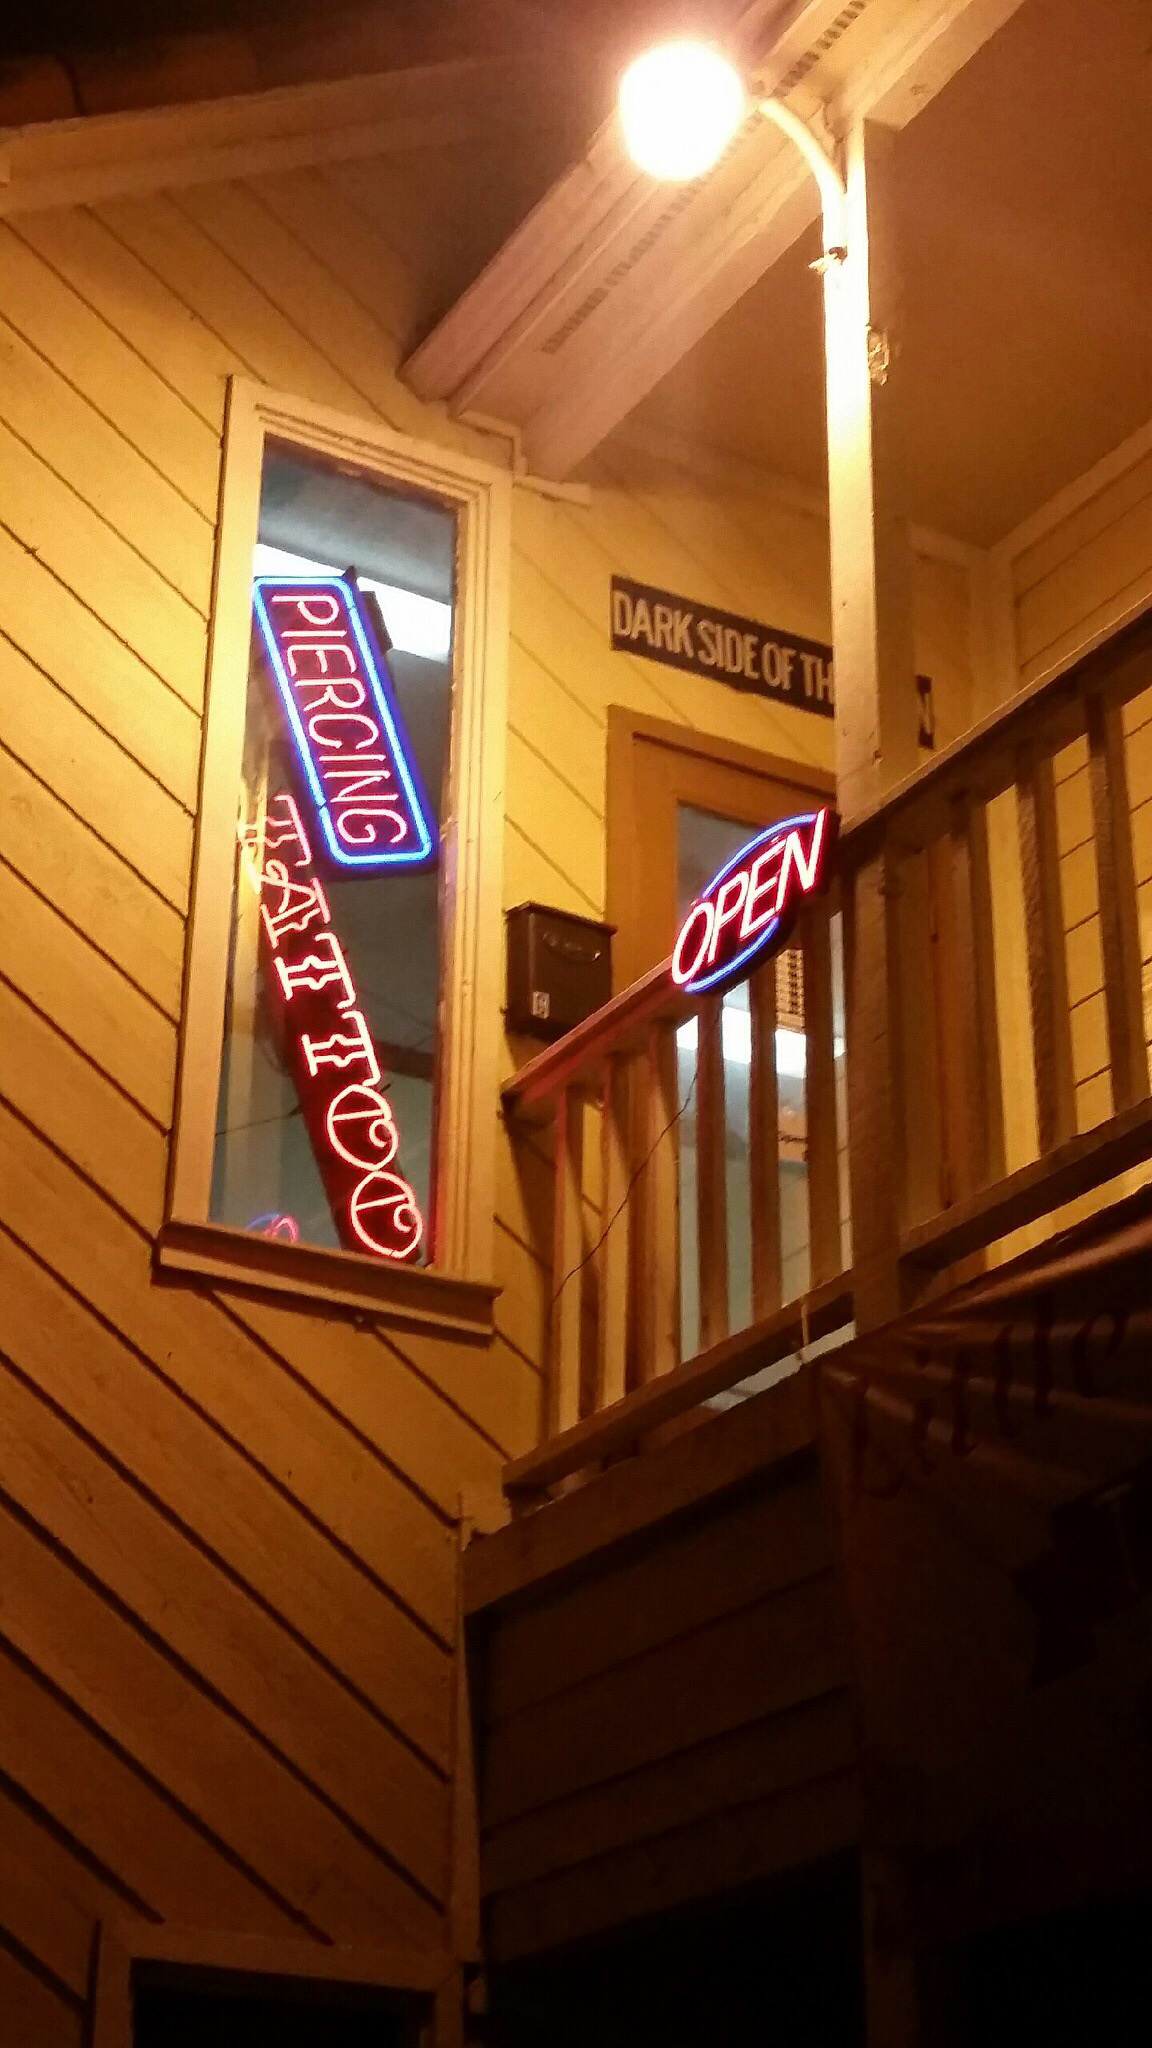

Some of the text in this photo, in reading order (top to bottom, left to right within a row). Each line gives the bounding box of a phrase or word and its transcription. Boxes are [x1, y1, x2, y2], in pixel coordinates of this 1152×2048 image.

[271, 594, 408, 844] PIERCING
[612, 590, 834, 704] DARK SIDE OF TH
[671, 806, 829, 986] OPEN
[238, 793, 424, 1258] TATTOO
